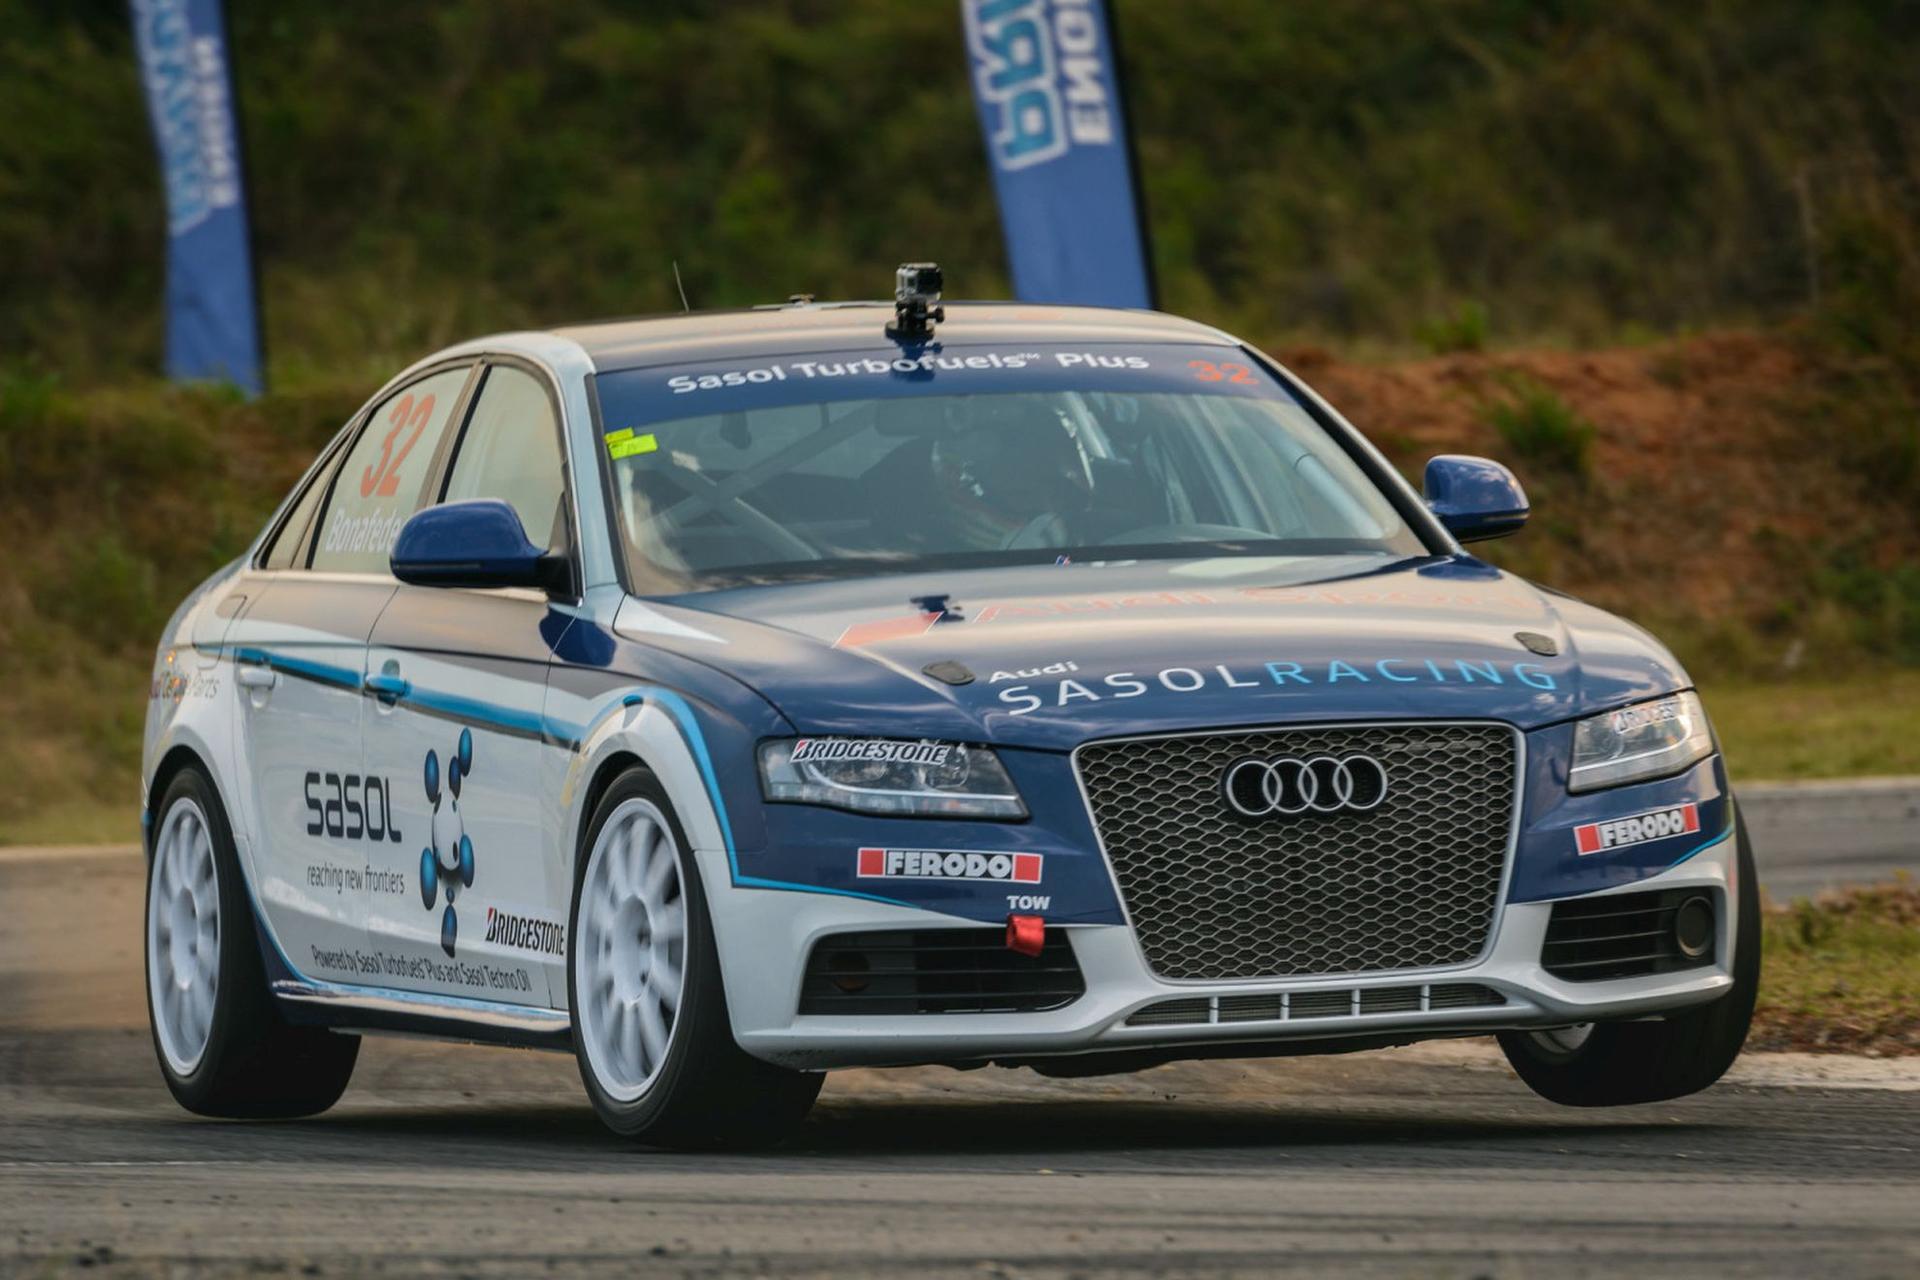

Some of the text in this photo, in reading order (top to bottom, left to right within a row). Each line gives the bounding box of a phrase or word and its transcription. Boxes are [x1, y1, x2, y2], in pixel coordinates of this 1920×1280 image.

[667, 364, 787, 394] Sasol
[1054, 352, 1150, 370] Plus
[1187, 359, 1260, 385] 32
[360, 393, 436, 498] 32
[988, 659, 1079, 684] Audi
[998, 658, 1558, 716] SASOL RACING
[791, 739, 951, 766] BRIDGESTONE
[1600, 810, 1685, 847] FERODO
[307, 861, 405, 895] reaching new frontiers
[886, 851, 1013, 879] FERODO
[1007, 895, 1050, 910] TOW
[485, 907, 564, 956] BRIDGESTONE
[311, 944, 347, 971] Powered
[344, 948, 359, 977] by
[356, 949, 381, 974] Sasol
[422, 957, 446, 982] Plus
[443, 961, 463, 984] and
[460, 962, 486, 987] Sasol
[484, 965, 518, 990] Techno
[515, 968, 532, 992] Oil
